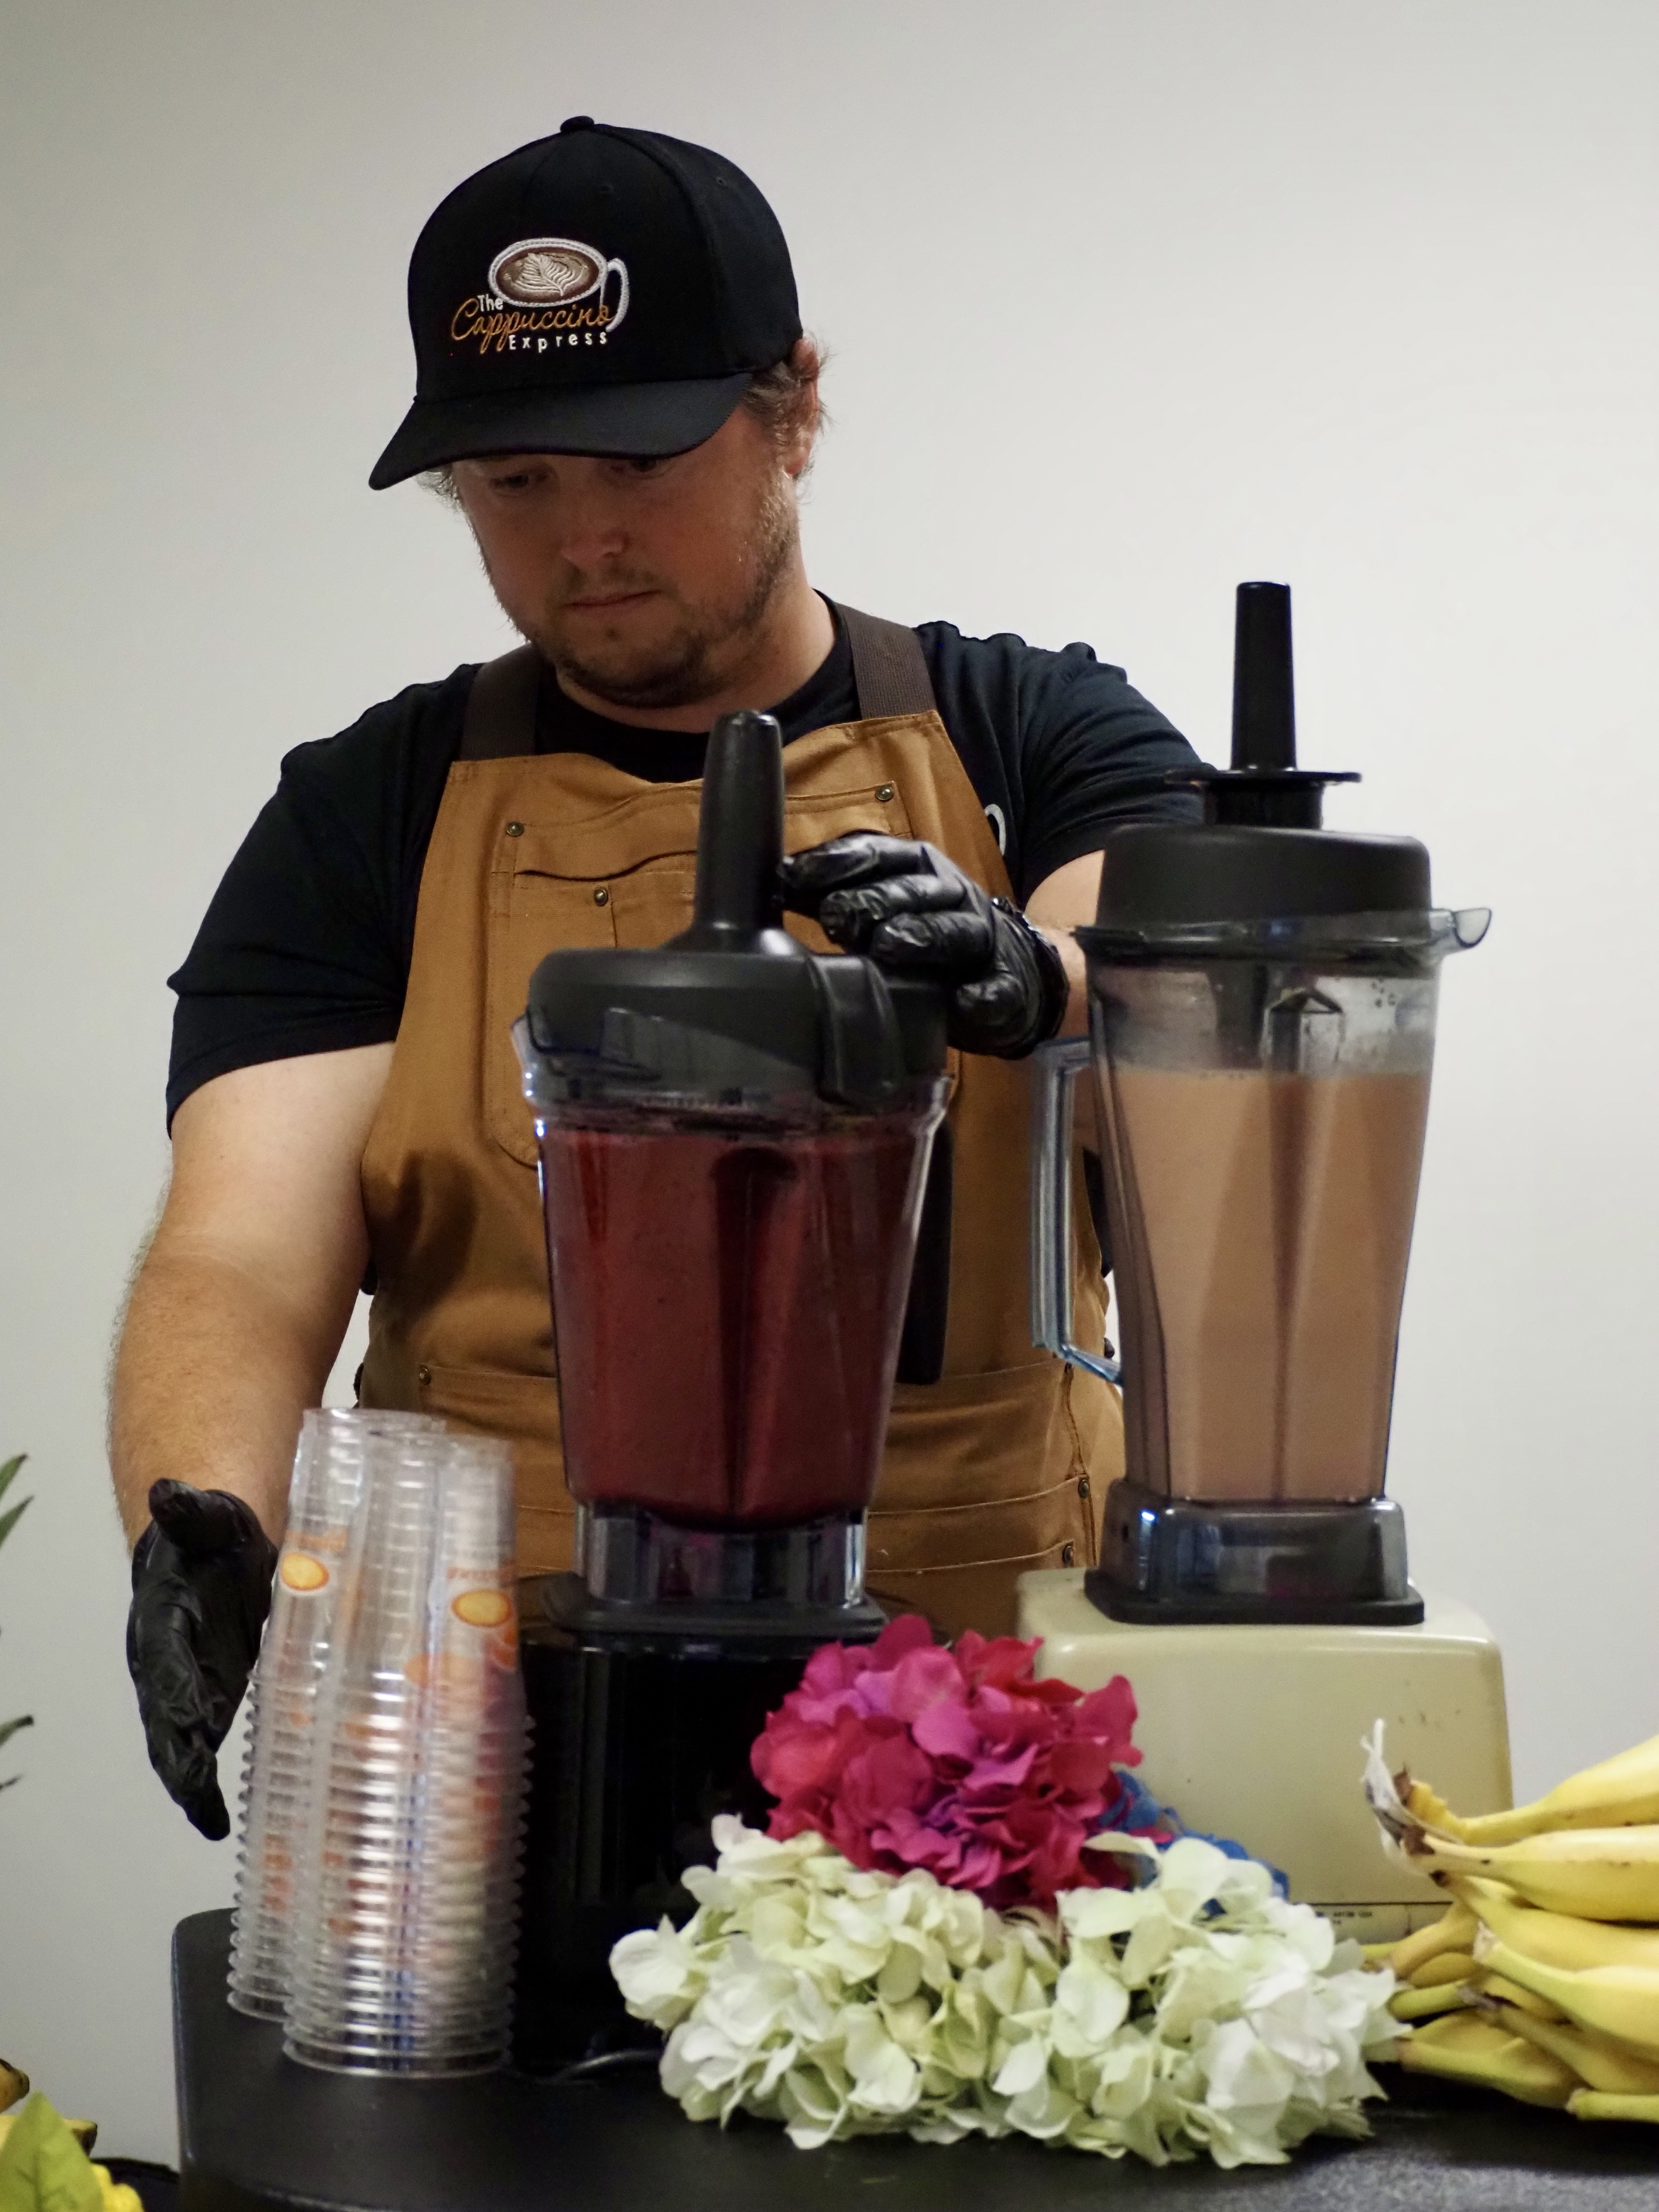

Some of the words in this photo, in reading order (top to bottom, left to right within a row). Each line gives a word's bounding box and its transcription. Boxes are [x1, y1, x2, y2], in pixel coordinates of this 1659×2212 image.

[477, 294, 504, 312] The
[451, 298, 614, 355] Cappuccino
[509, 332, 608, 353] Express
